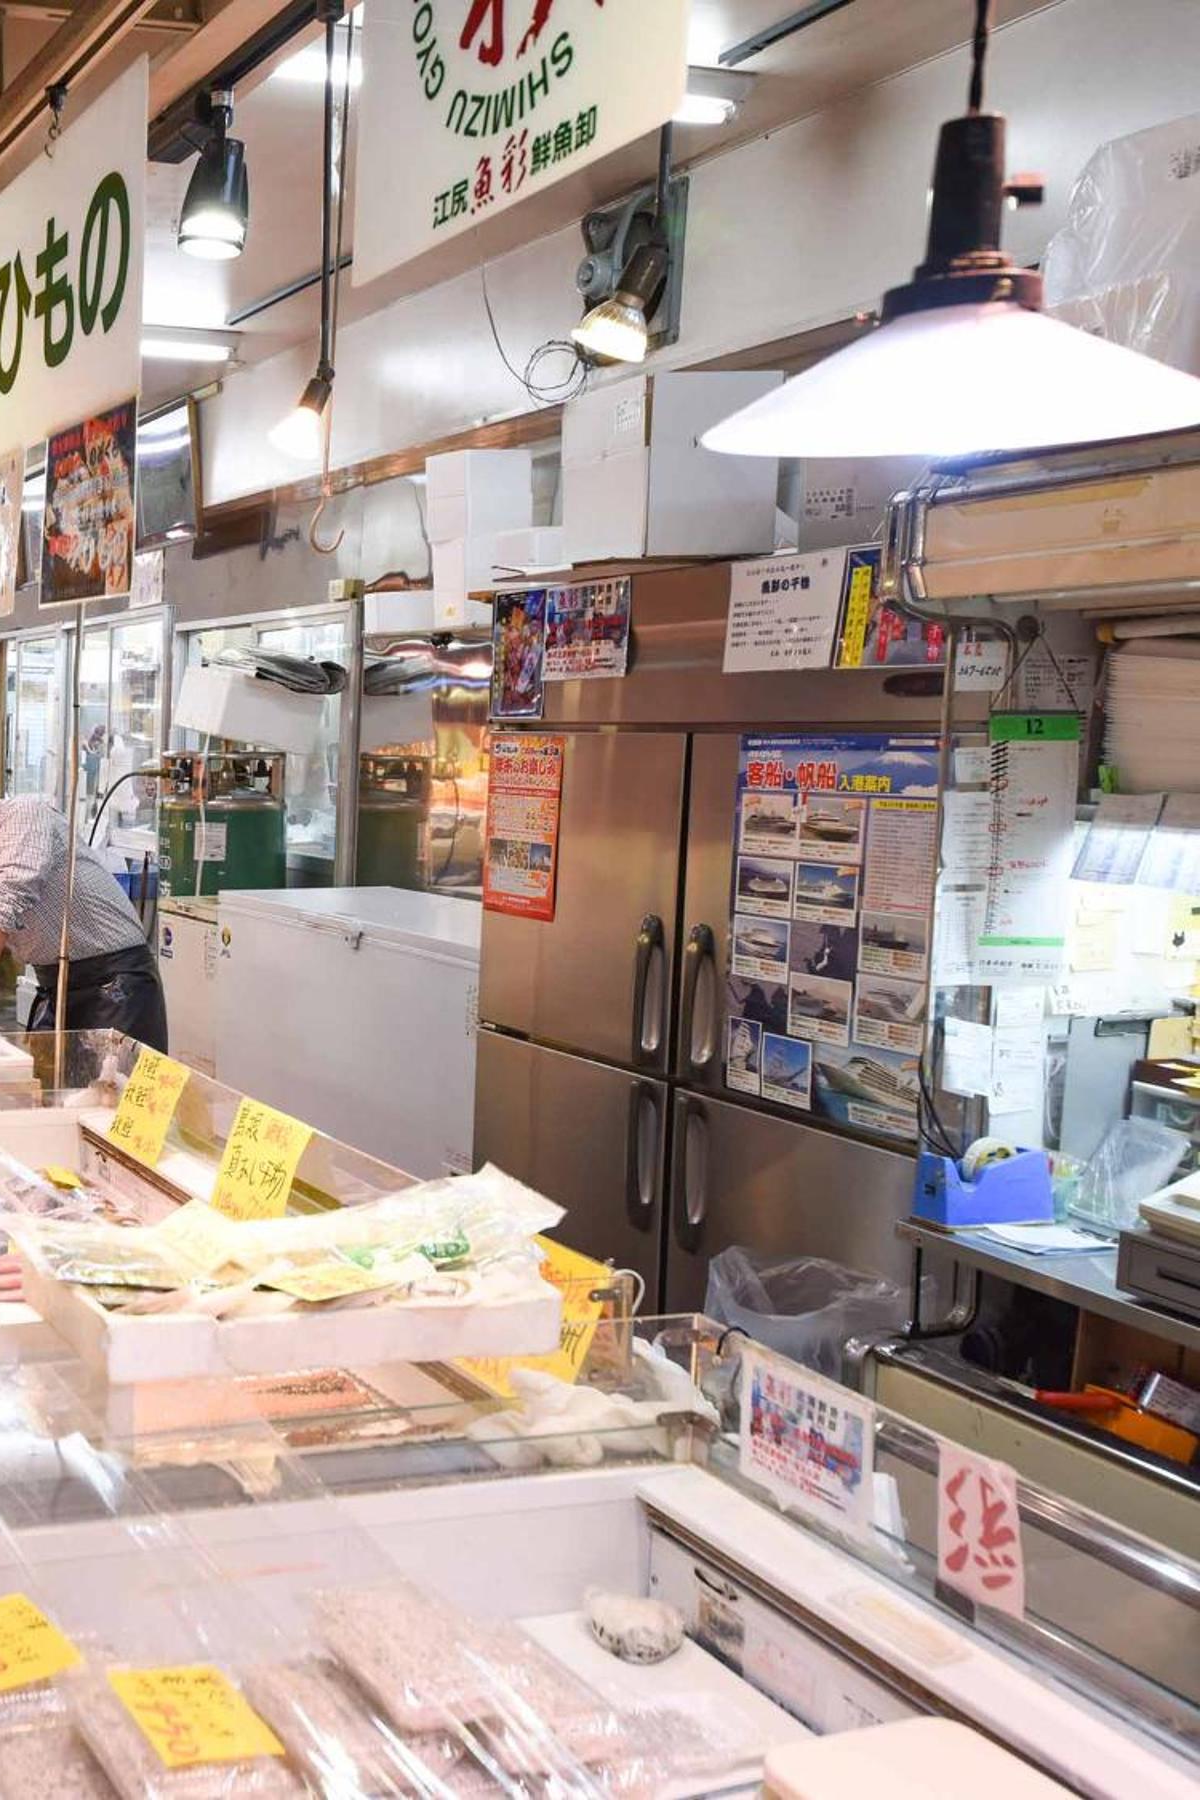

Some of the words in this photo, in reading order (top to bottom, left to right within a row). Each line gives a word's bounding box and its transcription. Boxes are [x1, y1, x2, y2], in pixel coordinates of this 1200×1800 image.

[412, 0, 445, 100] GYO
[446, 31, 574, 137] SHIMIZU
[1026, 718, 1044, 735] 12
